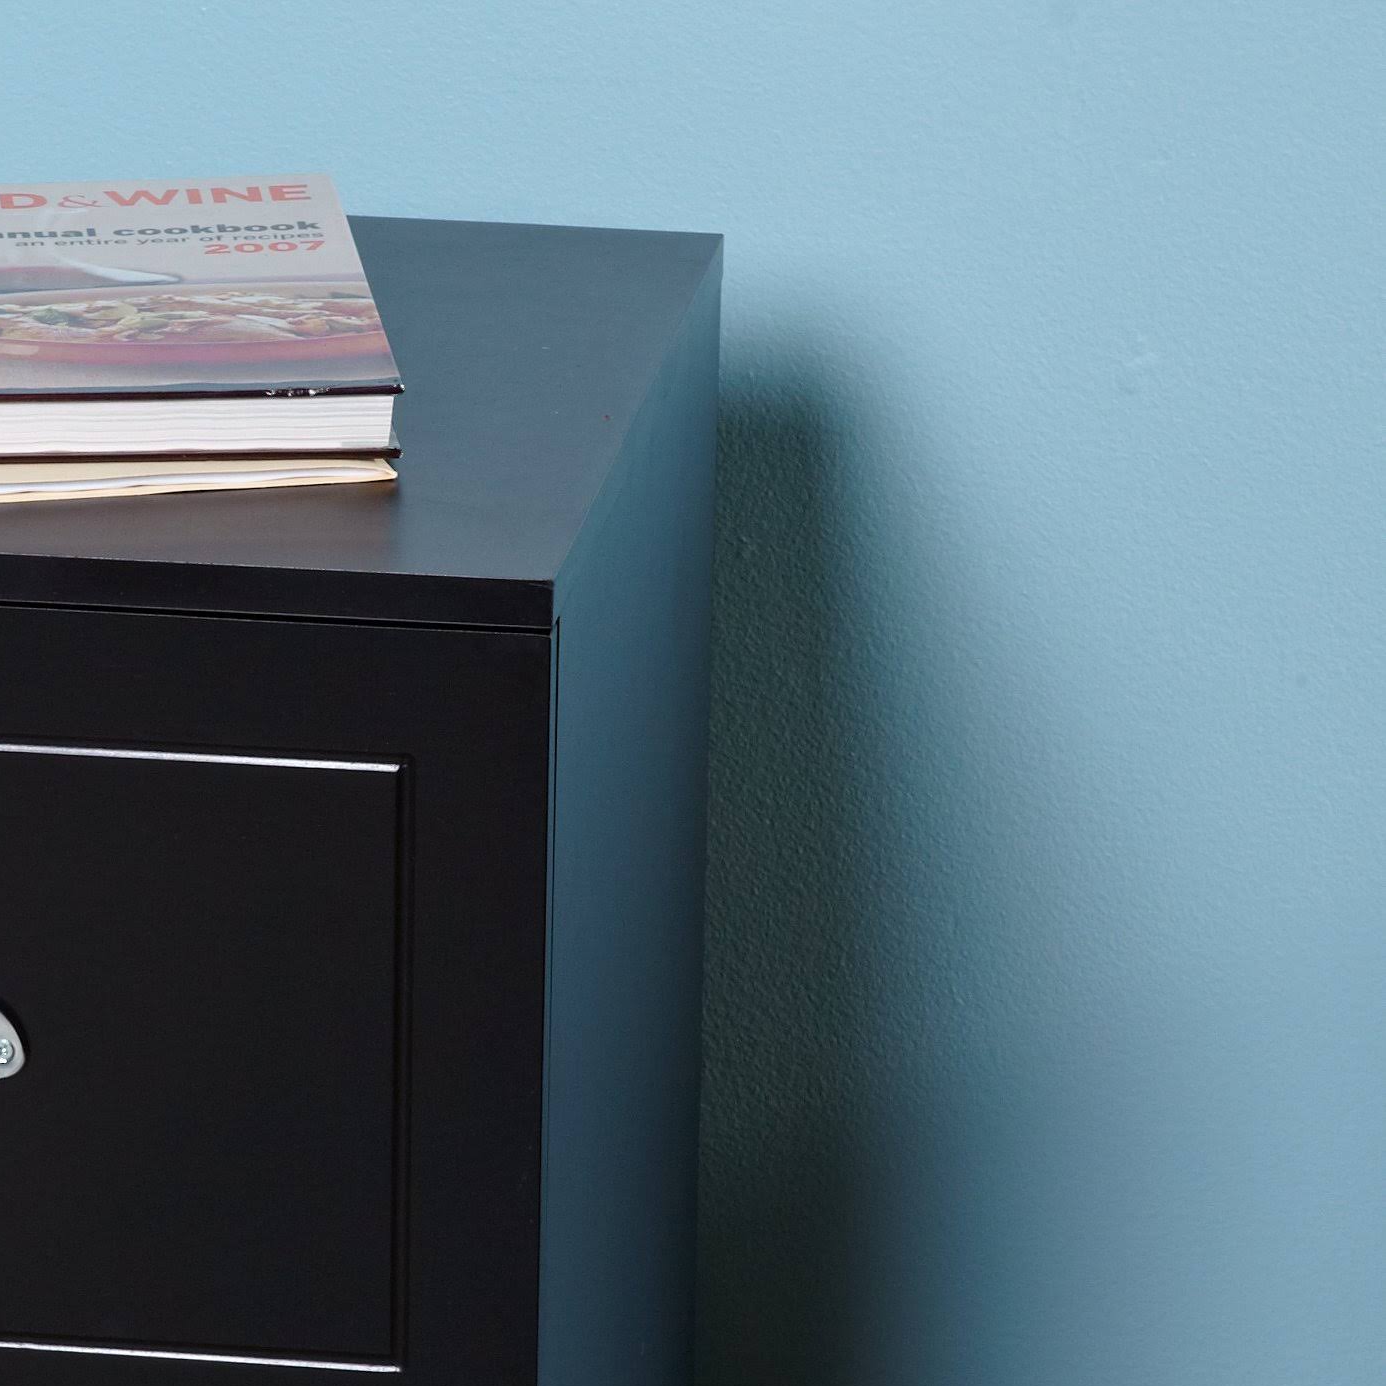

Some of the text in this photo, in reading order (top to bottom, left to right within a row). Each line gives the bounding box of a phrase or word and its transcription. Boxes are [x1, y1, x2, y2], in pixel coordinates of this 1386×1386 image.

[57, 194, 110, 209] &
[103, 184, 313, 207] WINE
[113, 221, 321, 237] cookbook
[54, 238, 128, 246] entire
[137, 236, 190, 246] year
[199, 234, 219, 242] of
[230, 231, 325, 242] recipes
[204, 240, 326, 255] 2007
